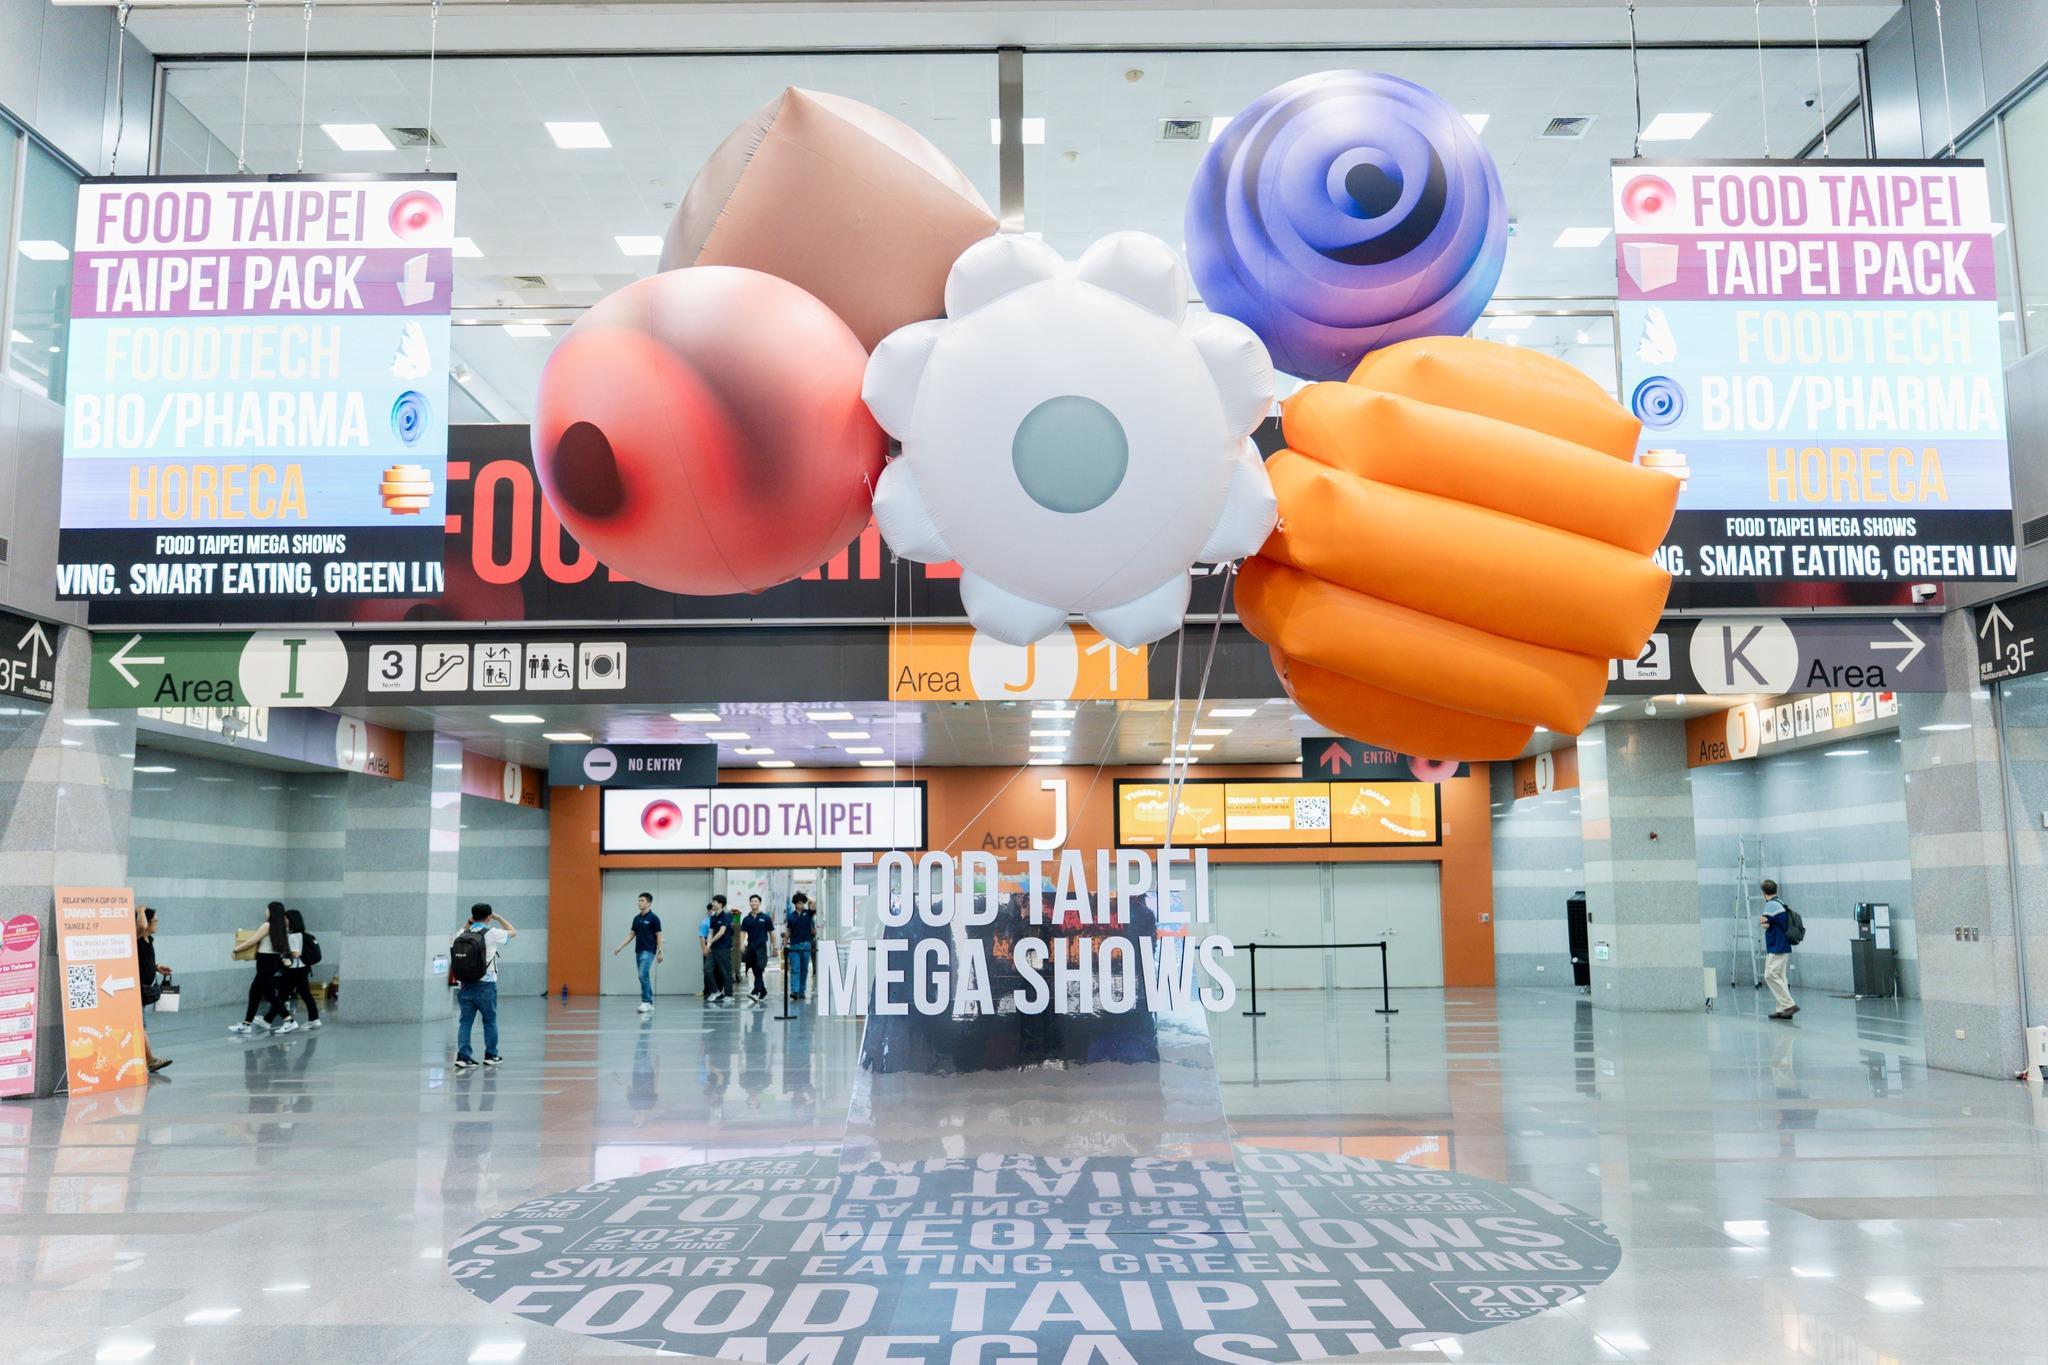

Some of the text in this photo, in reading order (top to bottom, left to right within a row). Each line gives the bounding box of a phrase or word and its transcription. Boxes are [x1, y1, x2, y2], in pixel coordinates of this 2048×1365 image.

[96, 190, 366, 244] FOOD TAIPEI
[1692, 174, 1962, 227] FOOD TAIPEI
[90, 255, 367, 313] TAIPEI PACK
[1697, 240, 1976, 296] TAIPEI PACK
[104, 325, 341, 381] FOODTECH
[1735, 310, 1972, 364] FOODTECH
[73, 391, 370, 449] BIO/PHARMA
[1701, 375, 2000, 432] BIO/PHARMA
[1766, 447, 1949, 503] HORECA
[128, 464, 308, 521] HORECA
[1726, 517, 1917, 537] FOOD TAIPEI MEGA SHOWS
[156, 534, 346, 555] FOOD TAIPEI MEGA SHOWS
[129, 564, 217, 595] SMART
[222, 562, 318, 598] EATING,
[324, 561, 403, 594] GREEN
[1700, 545, 1785, 577] SMART
[1792, 545, 1888, 580] EATING,
[1894, 545, 1975, 576] GREEN
[1980, 545, 2017, 576] LIV
[280, 639, 306, 698] I
[382, 651, 403, 680] 3
[1004, 640, 1037, 693] J
[1635, 640, 1657, 669] 2
[1722, 626, 1769, 686] K
[2006, 637, 2034, 674] 3F
[0, 658, 27, 691] 3F
[154, 673, 234, 702] Area
[382, 681, 401, 689] North
[896, 666, 961, 693] Area
[1807, 659, 1886, 688] Area
[1815, 707, 1830, 720] ATM
[1834, 701, 1851, 714] TAXI
[346, 724, 355, 765] J
[1738, 712, 1747, 753] J
[628, 757, 683, 772] NO ENTRY
[1363, 751, 1399, 765] ENTRY
[1700, 740, 1727, 762] Area
[509, 768, 516, 798] J
[1124, 788, 1164, 801] YUMMY
[1523, 780, 1537, 795] Area
[694, 802, 873, 837] FOOD TAIPEI
[1033, 779, 1067, 850] J
[982, 832, 1029, 849] Area
[841, 847, 1210, 927] FOOD TAIPEI
[99, 907, 129, 919] SELECT
[817, 934, 1236, 1017] MEGA SHOWS
[1352, 1193, 1481, 1205] 2025
[597, 1228, 739, 1243] 2025
[670, 1241, 732, 1251] JUNE
[531, 1250, 1608, 1279] SMART EATING, GREEN LIVING.
[490, 1279, 1427, 1334] FOOD TAIPEI
